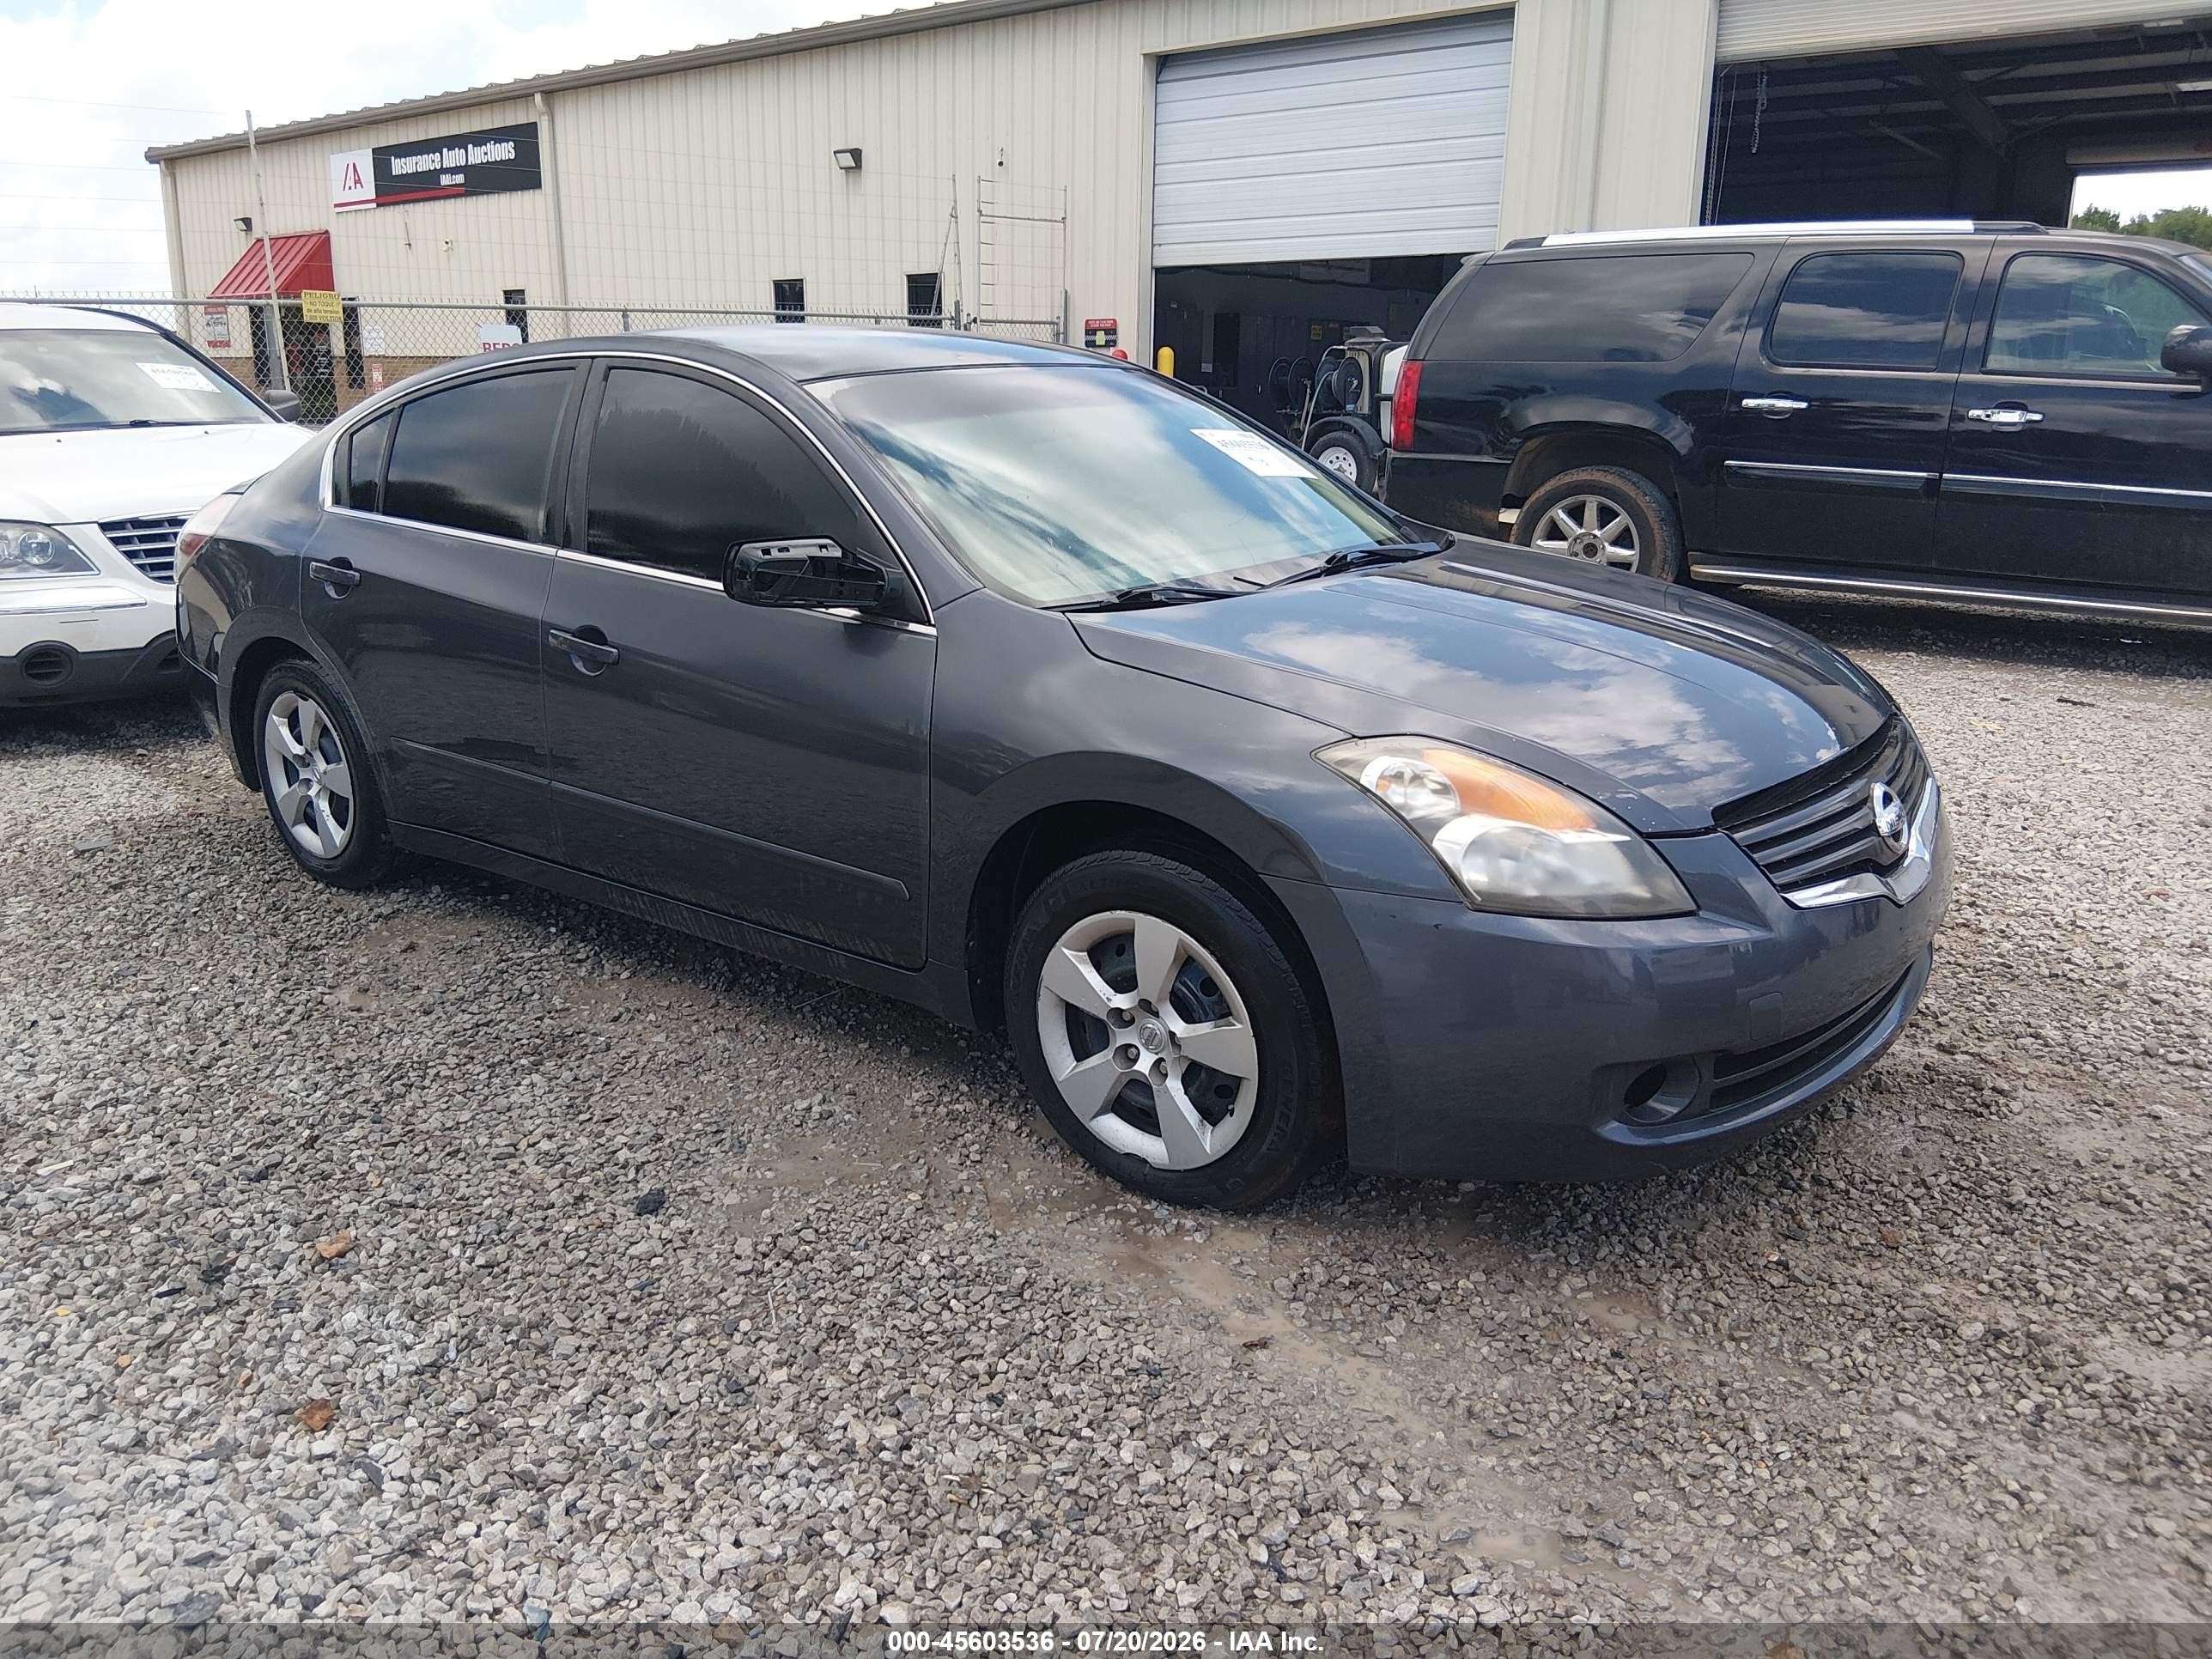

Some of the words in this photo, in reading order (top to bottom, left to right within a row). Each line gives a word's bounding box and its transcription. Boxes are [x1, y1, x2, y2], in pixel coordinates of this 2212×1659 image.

[391, 152, 441, 176] Insurance
[442, 147, 466, 168] Auto
[467, 140, 515, 165] Auctions
